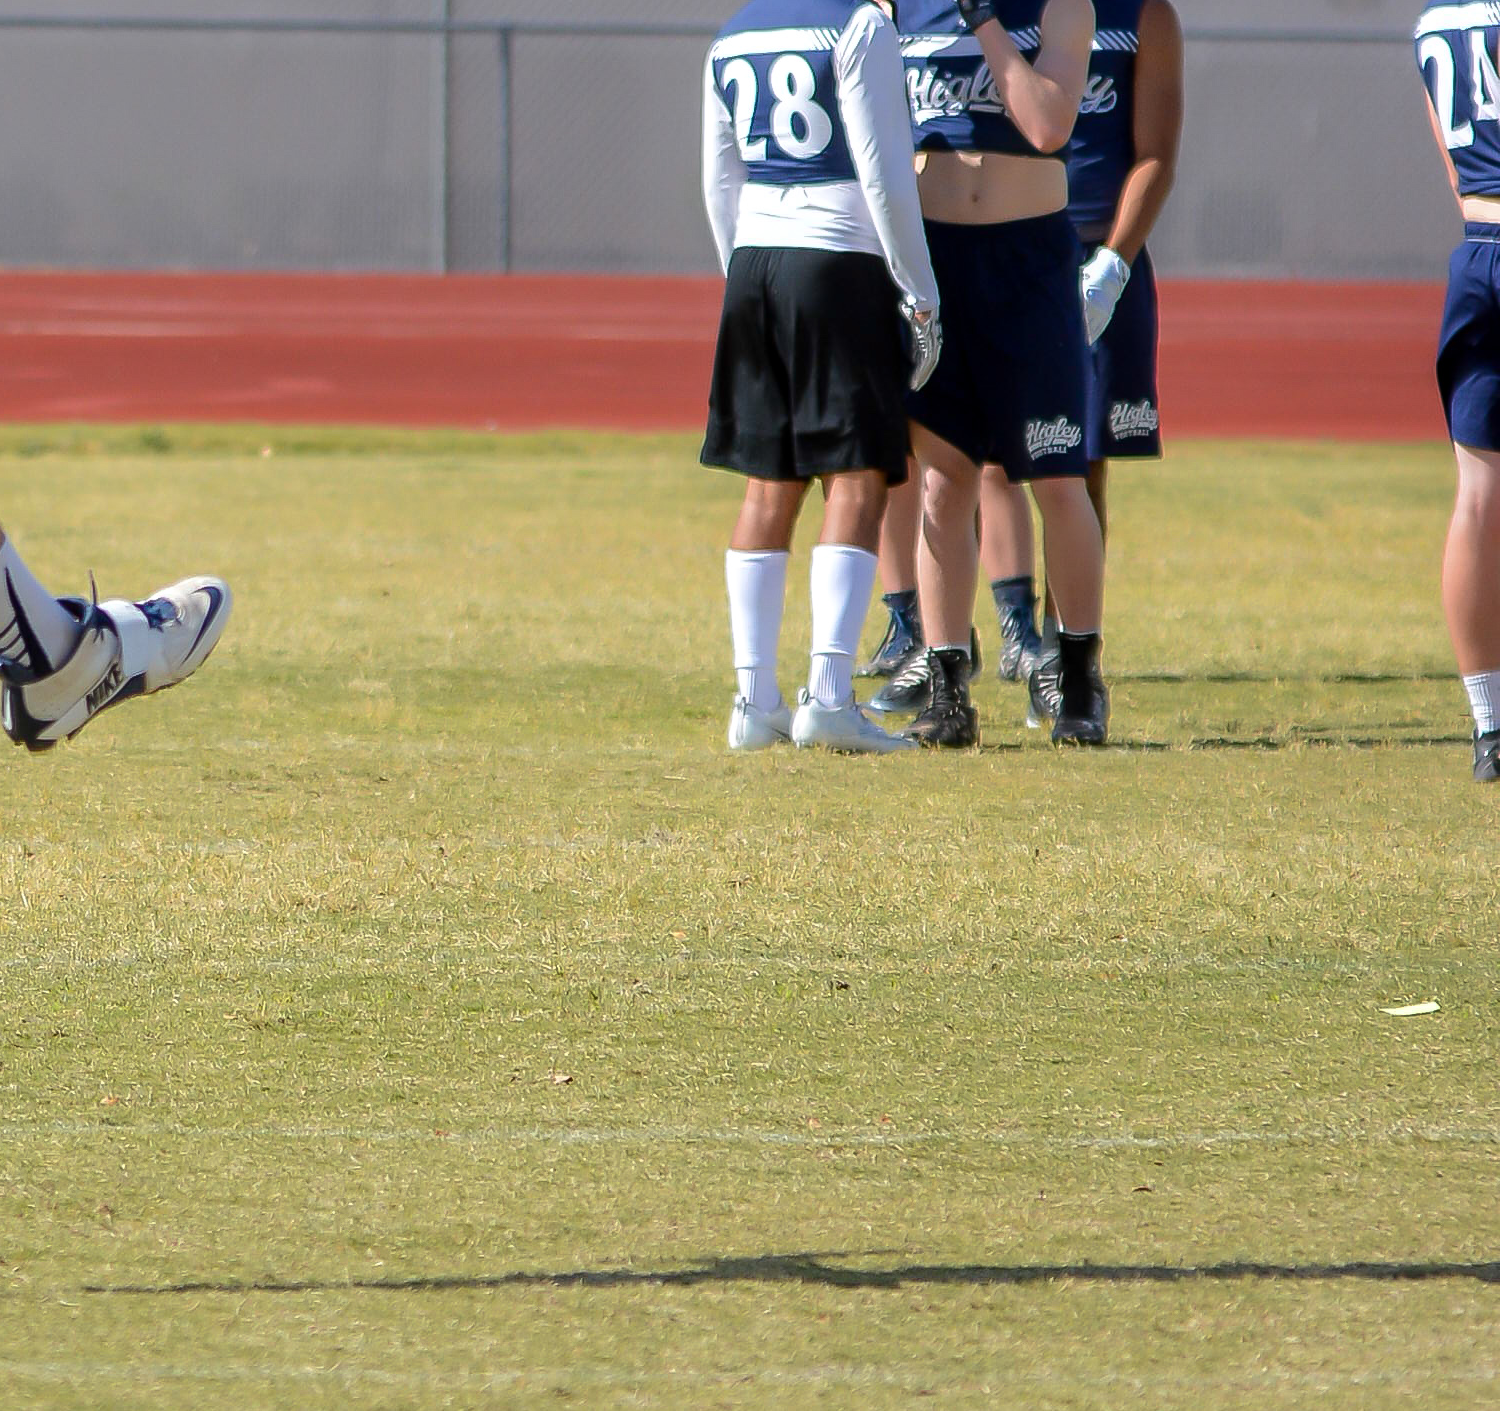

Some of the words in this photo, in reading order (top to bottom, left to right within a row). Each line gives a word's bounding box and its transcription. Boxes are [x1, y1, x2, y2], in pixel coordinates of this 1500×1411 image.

[722, 53, 833, 162] 28
[1026, 417, 1082, 448] Higley
[86, 661, 122, 715] NIKE
